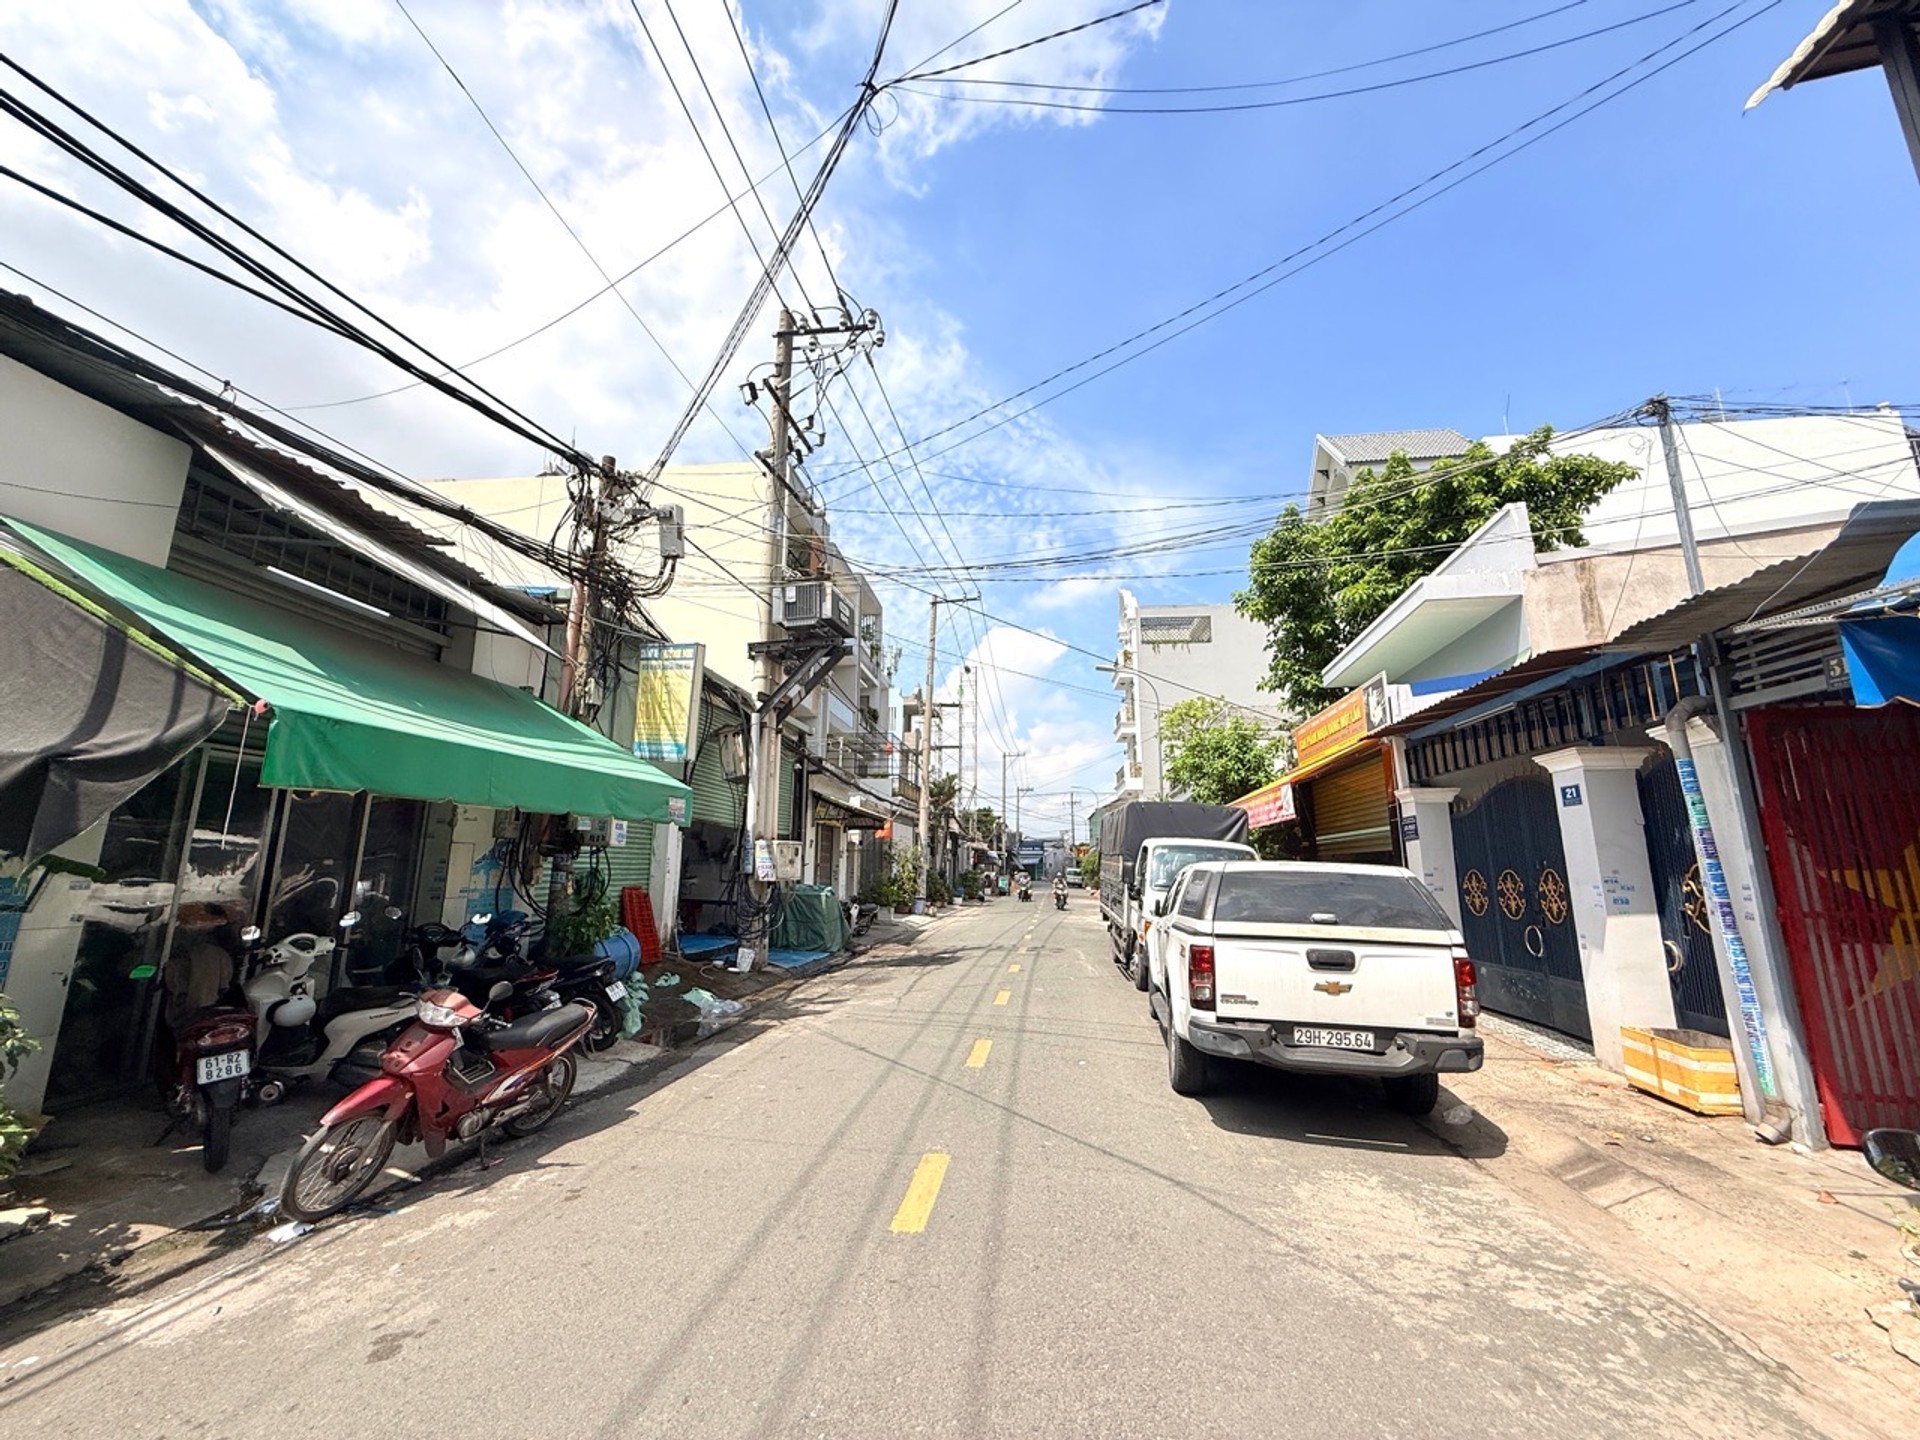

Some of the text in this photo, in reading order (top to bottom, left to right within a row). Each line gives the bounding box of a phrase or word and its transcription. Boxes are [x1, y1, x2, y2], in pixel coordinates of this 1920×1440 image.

[1565, 787, 1577, 798] 21
[1295, 1028, 1372, 1048] 29H-295.64
[205, 1064, 242, 1081] 8286
